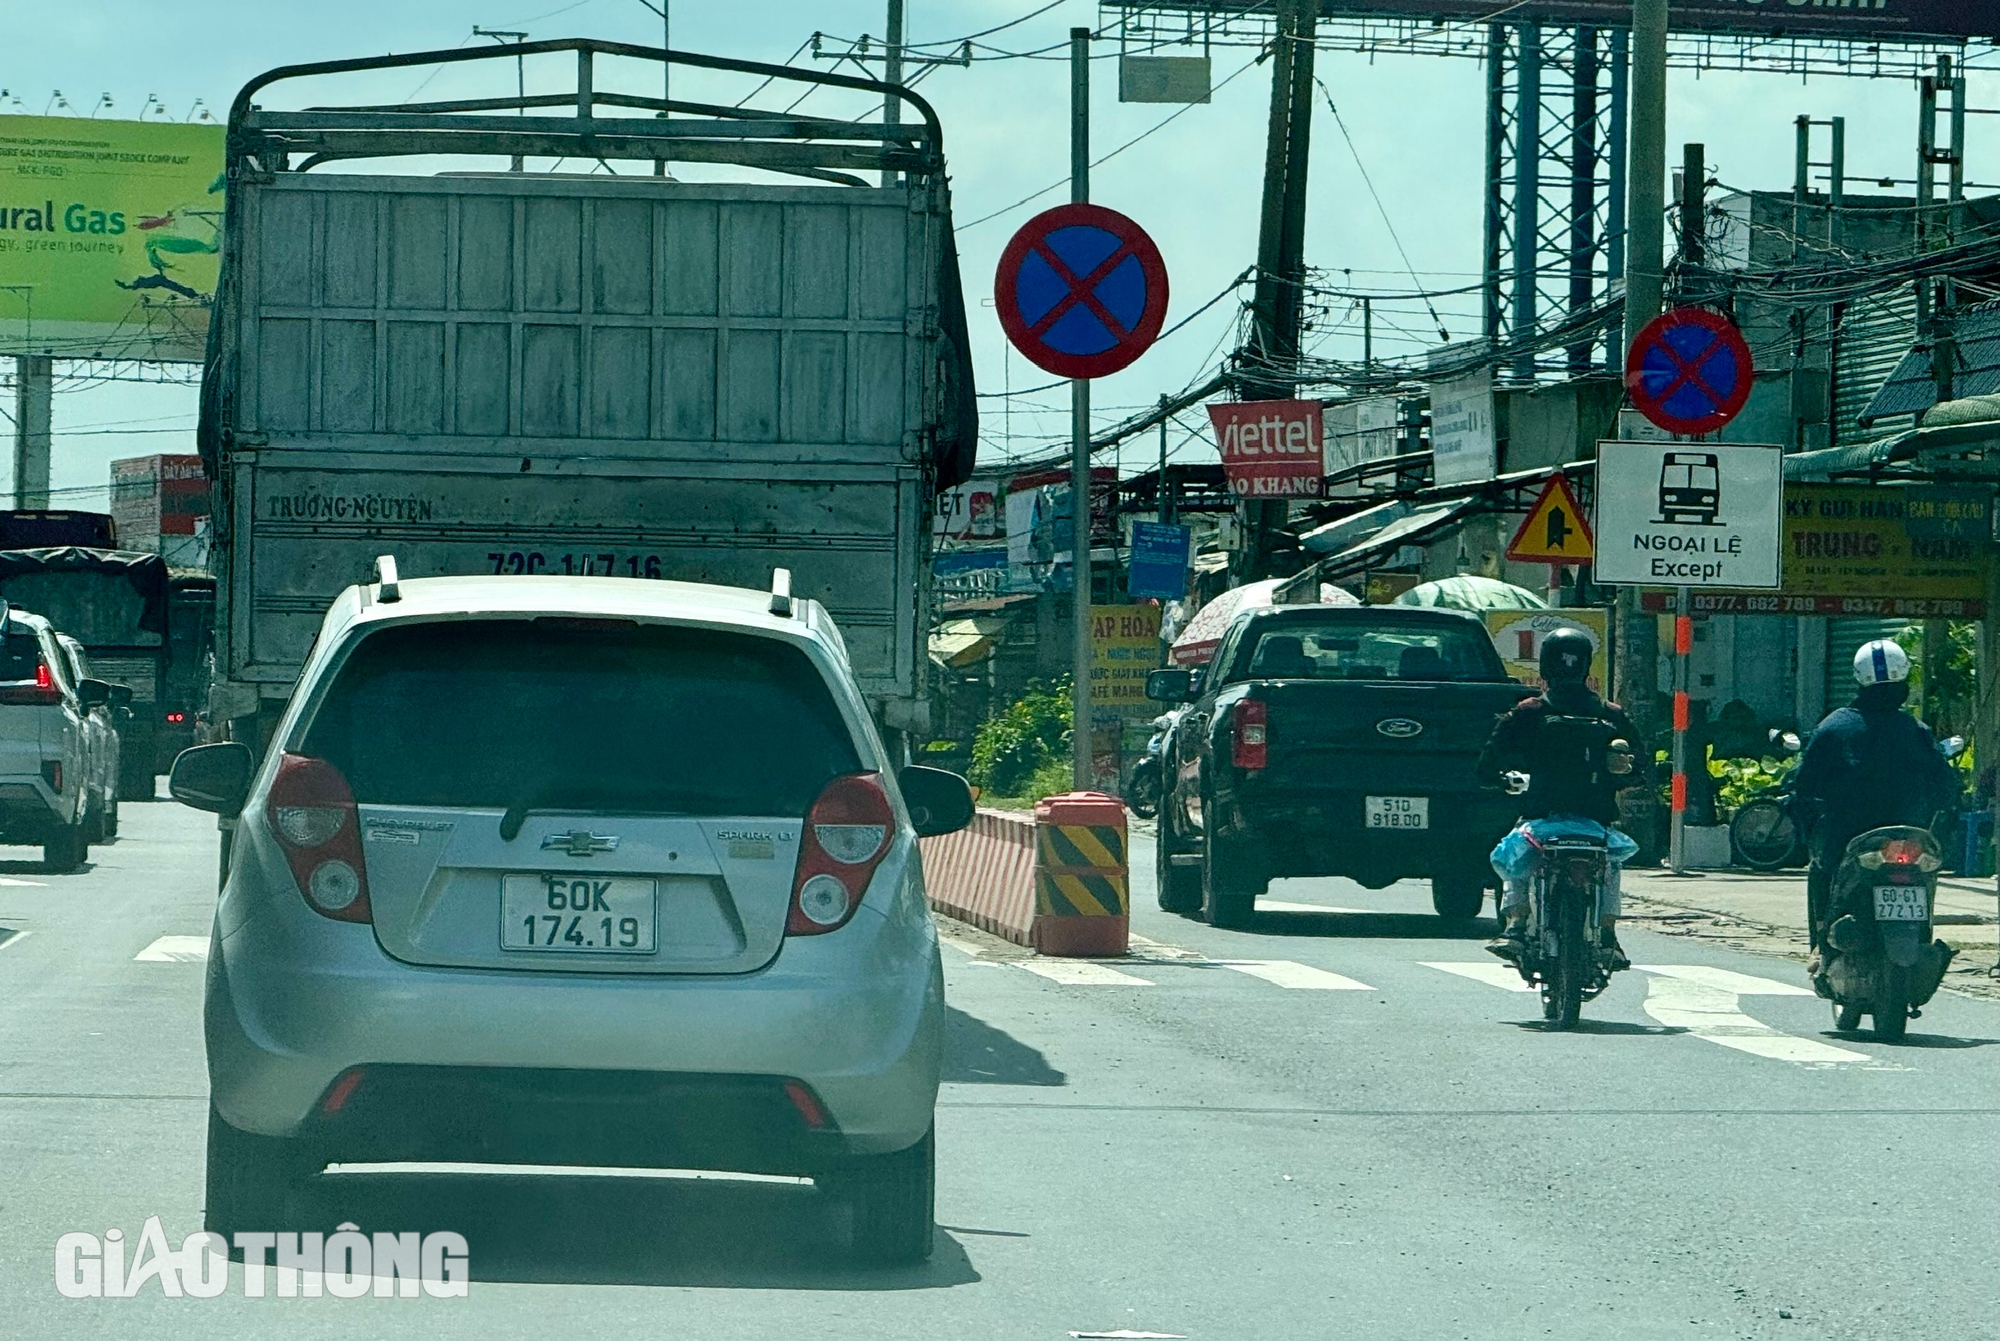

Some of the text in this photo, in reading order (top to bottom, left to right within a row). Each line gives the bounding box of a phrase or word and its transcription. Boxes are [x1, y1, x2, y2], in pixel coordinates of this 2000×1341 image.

[64, 203, 126, 235] Gas
[26, 240, 67, 253] green
[1214, 413, 1319, 457] viettel
[1252, 476, 1319, 495] KHANG
[1634, 533, 1742, 558] NGOẠI LỆ
[1792, 531, 1882, 560] TRUNG
[1651, 558, 1723, 581] Except
[1386, 722, 1412, 733] Ford
[716, 829, 772, 840] SPARK
[546, 880, 611, 912] 60K
[523, 915, 640, 948] 174.19
